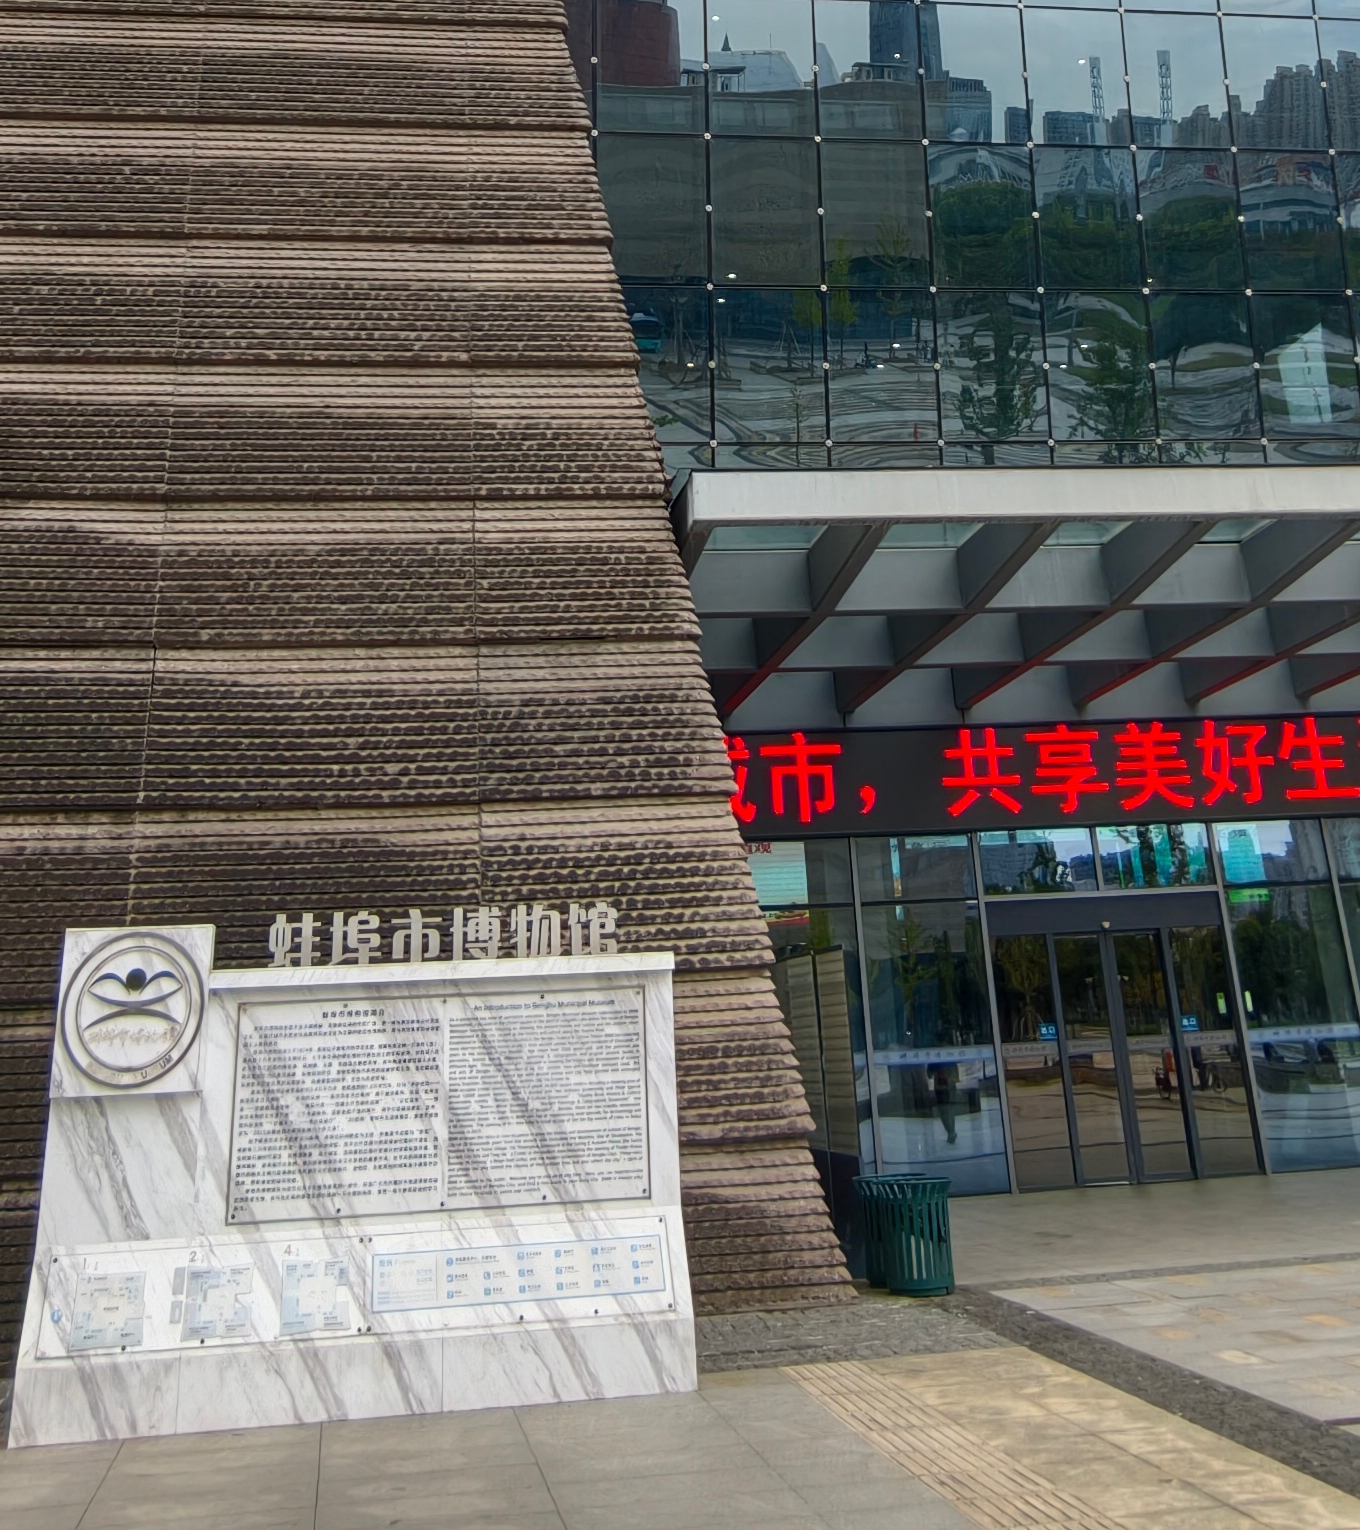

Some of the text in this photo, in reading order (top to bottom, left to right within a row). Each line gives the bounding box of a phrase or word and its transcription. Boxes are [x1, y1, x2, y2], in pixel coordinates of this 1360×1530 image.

[267, 902, 618, 967] 蚌埠市博物馆
